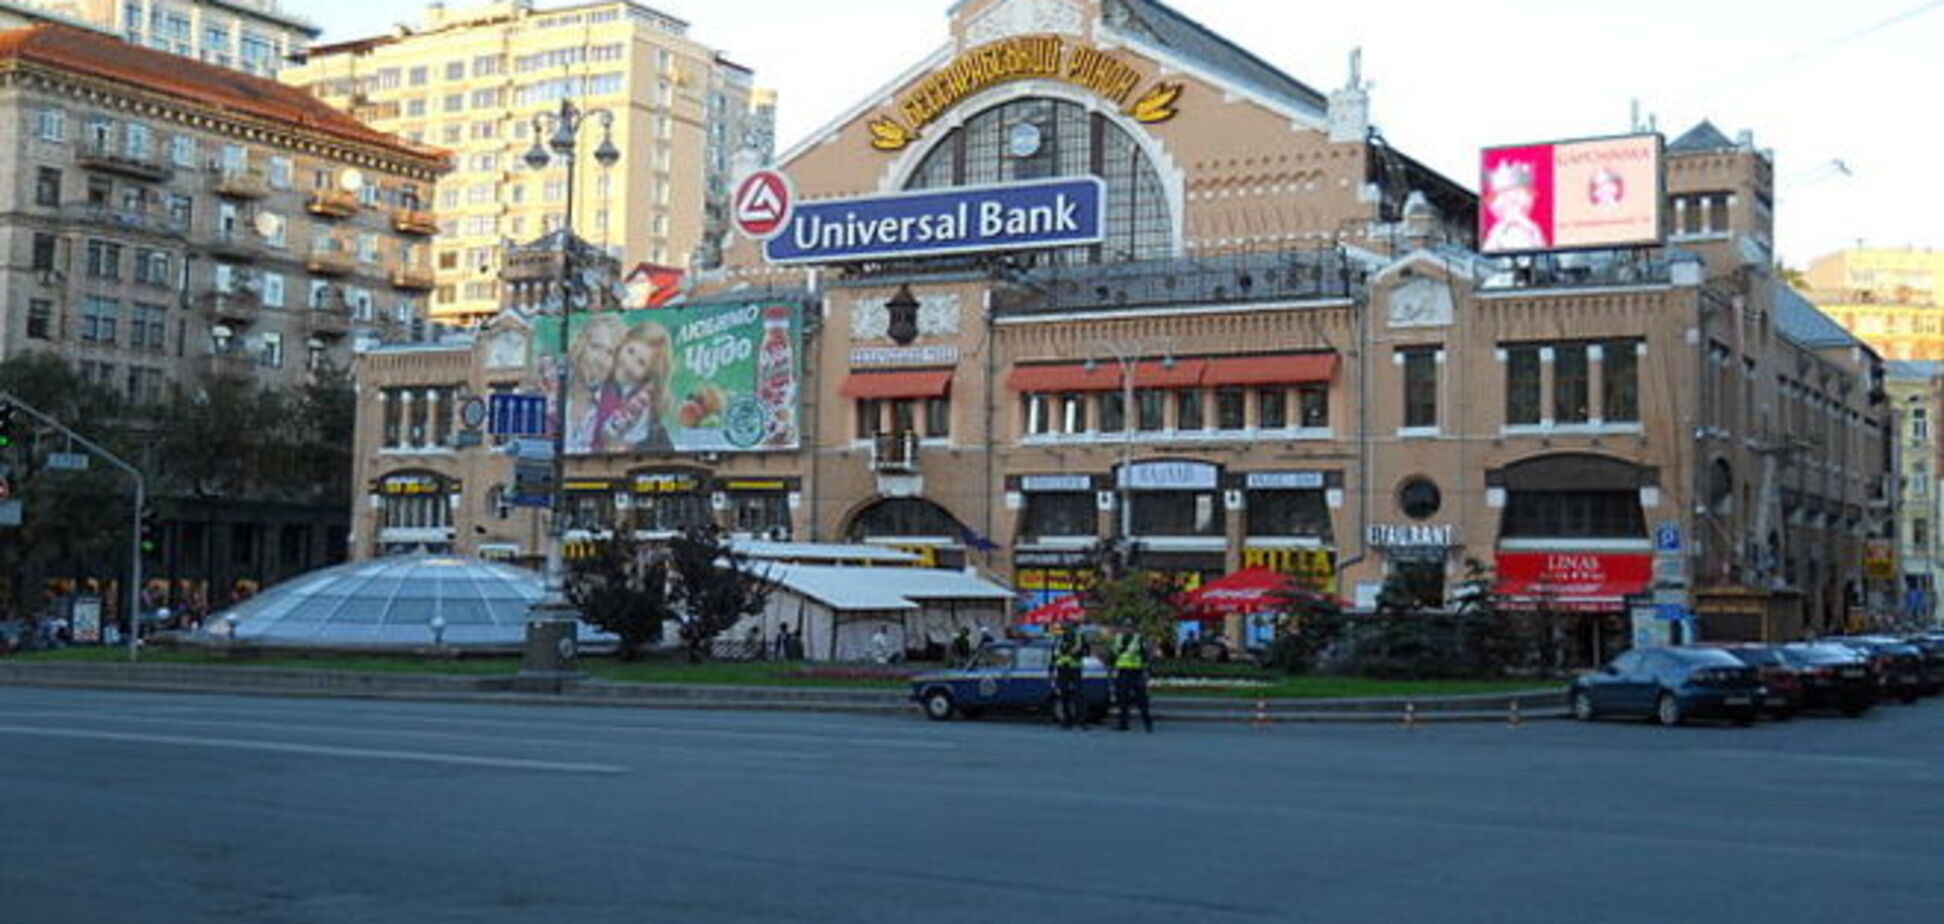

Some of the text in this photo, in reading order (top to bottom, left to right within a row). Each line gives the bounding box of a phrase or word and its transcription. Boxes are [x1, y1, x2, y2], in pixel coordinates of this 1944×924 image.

[794, 193, 1078, 249] Universal Bank
[685, 333, 753, 379] Чудо
